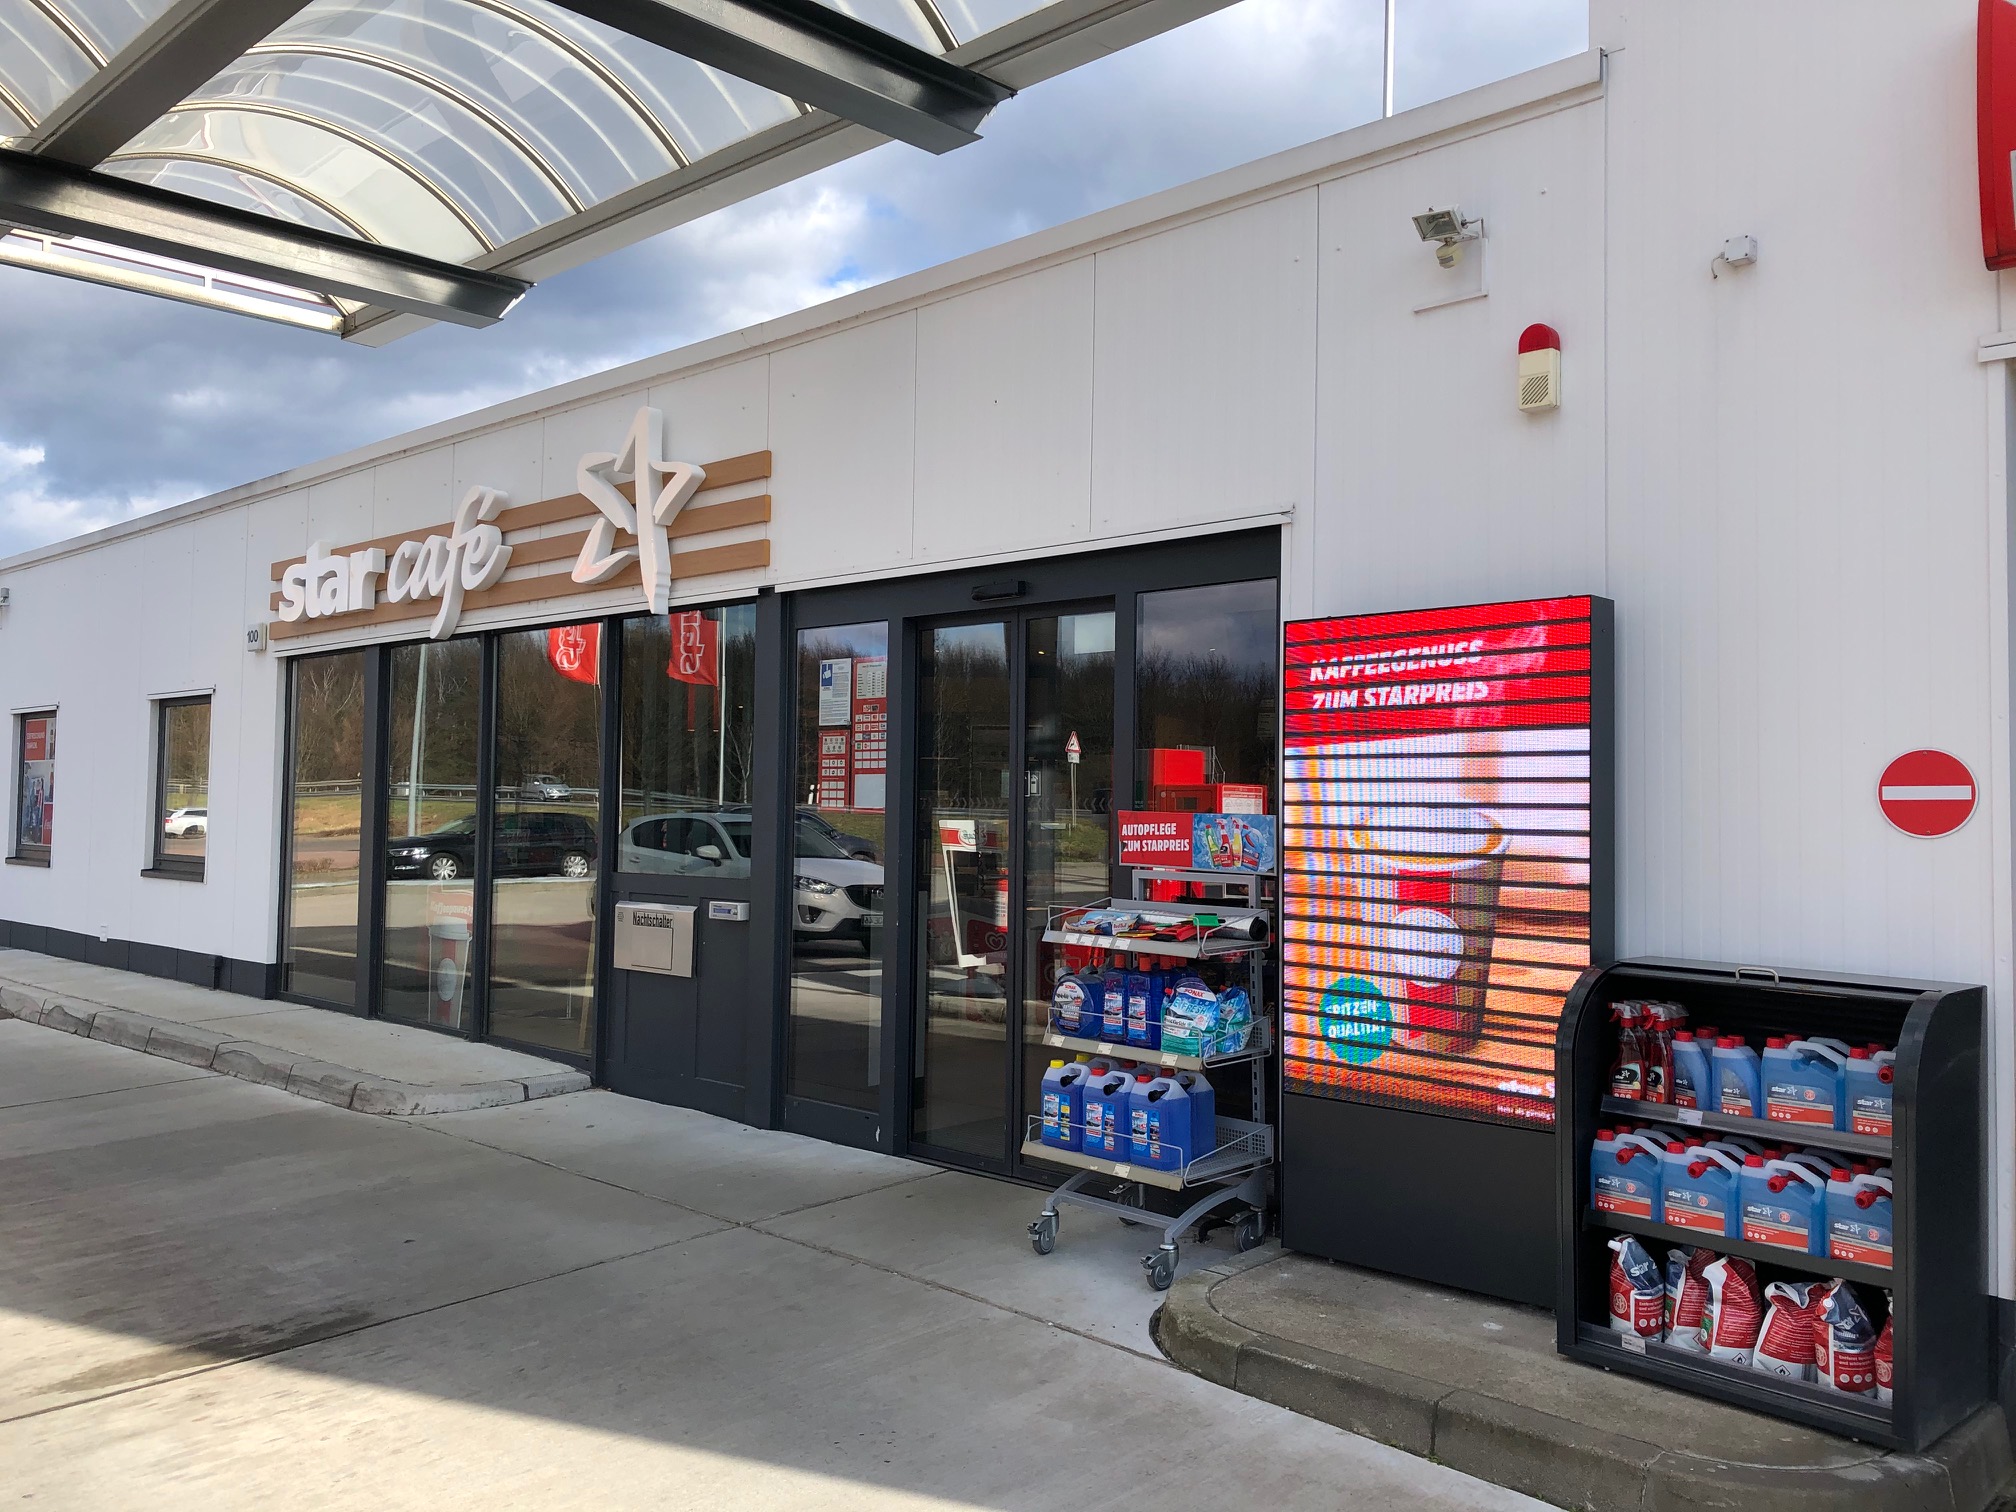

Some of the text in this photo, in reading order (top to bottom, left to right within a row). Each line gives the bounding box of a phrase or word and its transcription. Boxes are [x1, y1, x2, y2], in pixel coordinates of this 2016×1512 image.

[278, 484, 514, 640] star café
[246, 629, 259, 644] 100
[1309, 639, 1484, 682] KAFFEEGENUSS
[1312, 681, 1490, 709] ZUM STARPREIS
[1121, 822, 1177, 836] AUTOPFLEGE
[1123, 839, 1190, 852] ZUM STARPREIS
[632, 911, 673, 928] Nachtschalter
[1183, 988, 1205, 998] SONAX
[1771, 1085, 1787, 1094] star
[1857, 1098, 1874, 1107] star
[1598, 1177, 1611, 1185] star
[1668, 1189, 1681, 1198] star
[1747, 1205, 1762, 1213] star
[1833, 1221, 1850, 1231] star
[1630, 1260, 1649, 1277] star
